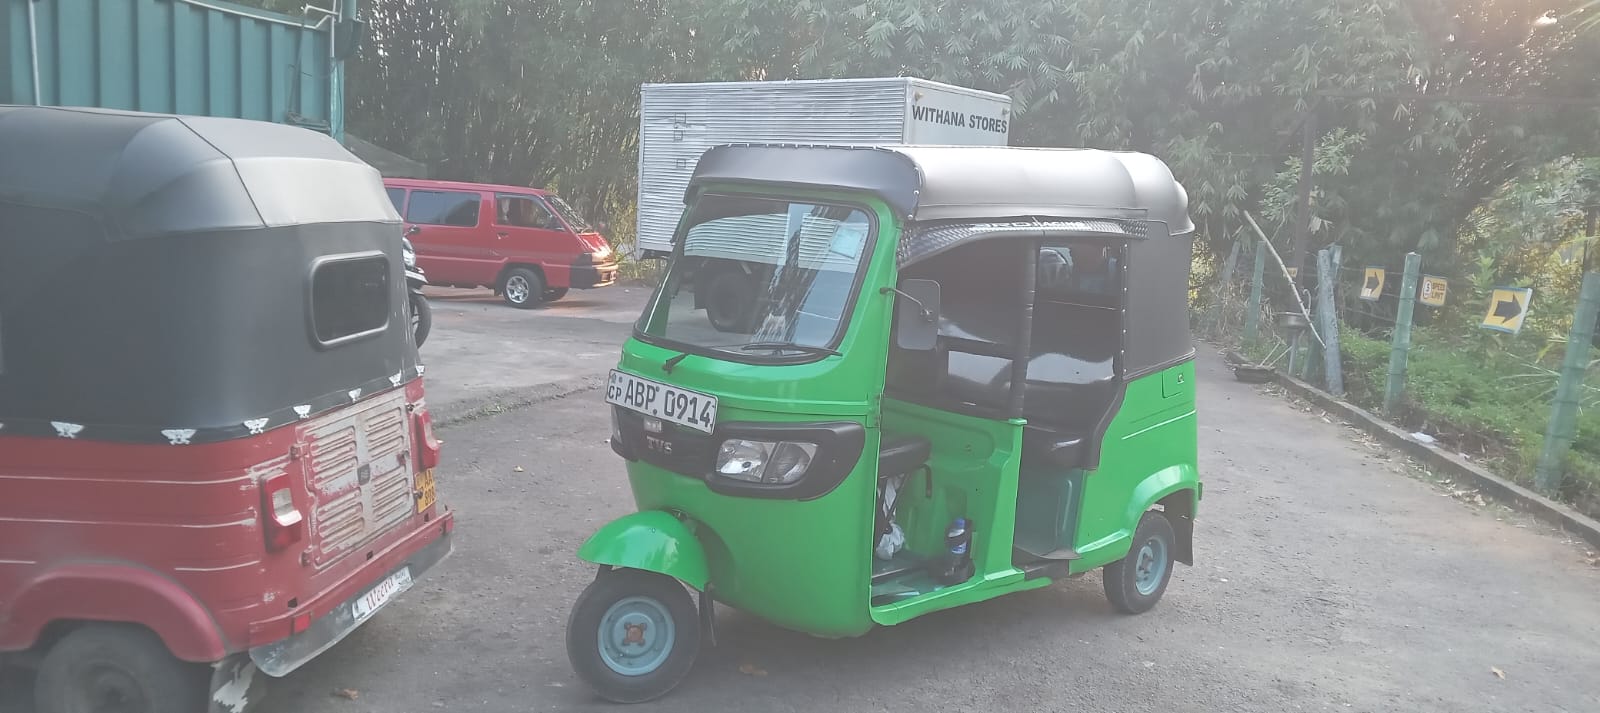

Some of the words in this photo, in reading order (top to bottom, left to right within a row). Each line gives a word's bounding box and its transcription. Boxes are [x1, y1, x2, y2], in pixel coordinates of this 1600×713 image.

[912, 104, 965, 128] WITHANA
[969, 114, 1008, 134] STORES
[608, 385, 622, 401] CP
[624, 379, 656, 410] ABP
[664, 389, 712, 428] 0914
[646, 435, 672, 452] TVS
